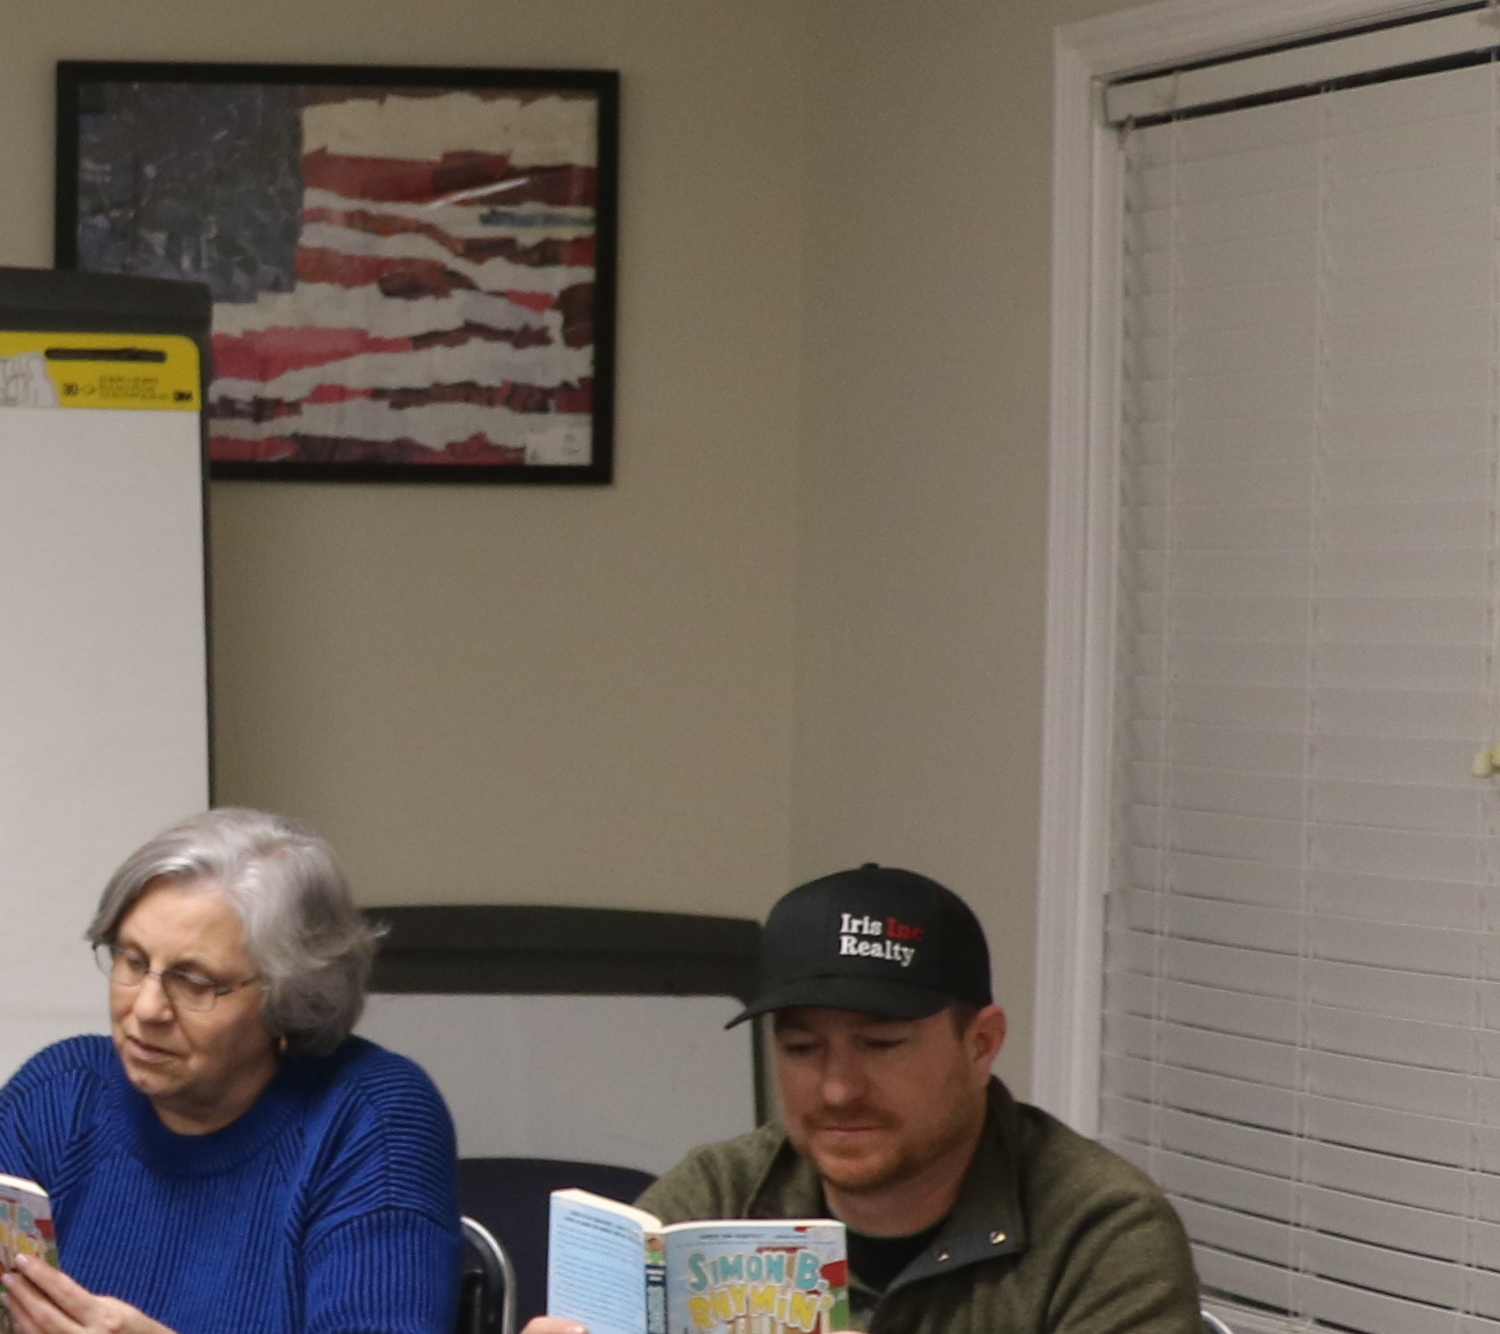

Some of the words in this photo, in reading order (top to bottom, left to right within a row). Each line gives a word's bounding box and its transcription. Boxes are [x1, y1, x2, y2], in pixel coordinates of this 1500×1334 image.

[840, 913, 882, 936] Iris
[839, 935, 916, 967] Realty
[688, 1252, 786, 1292] SIMON
[795, 1251, 829, 1291] B.
